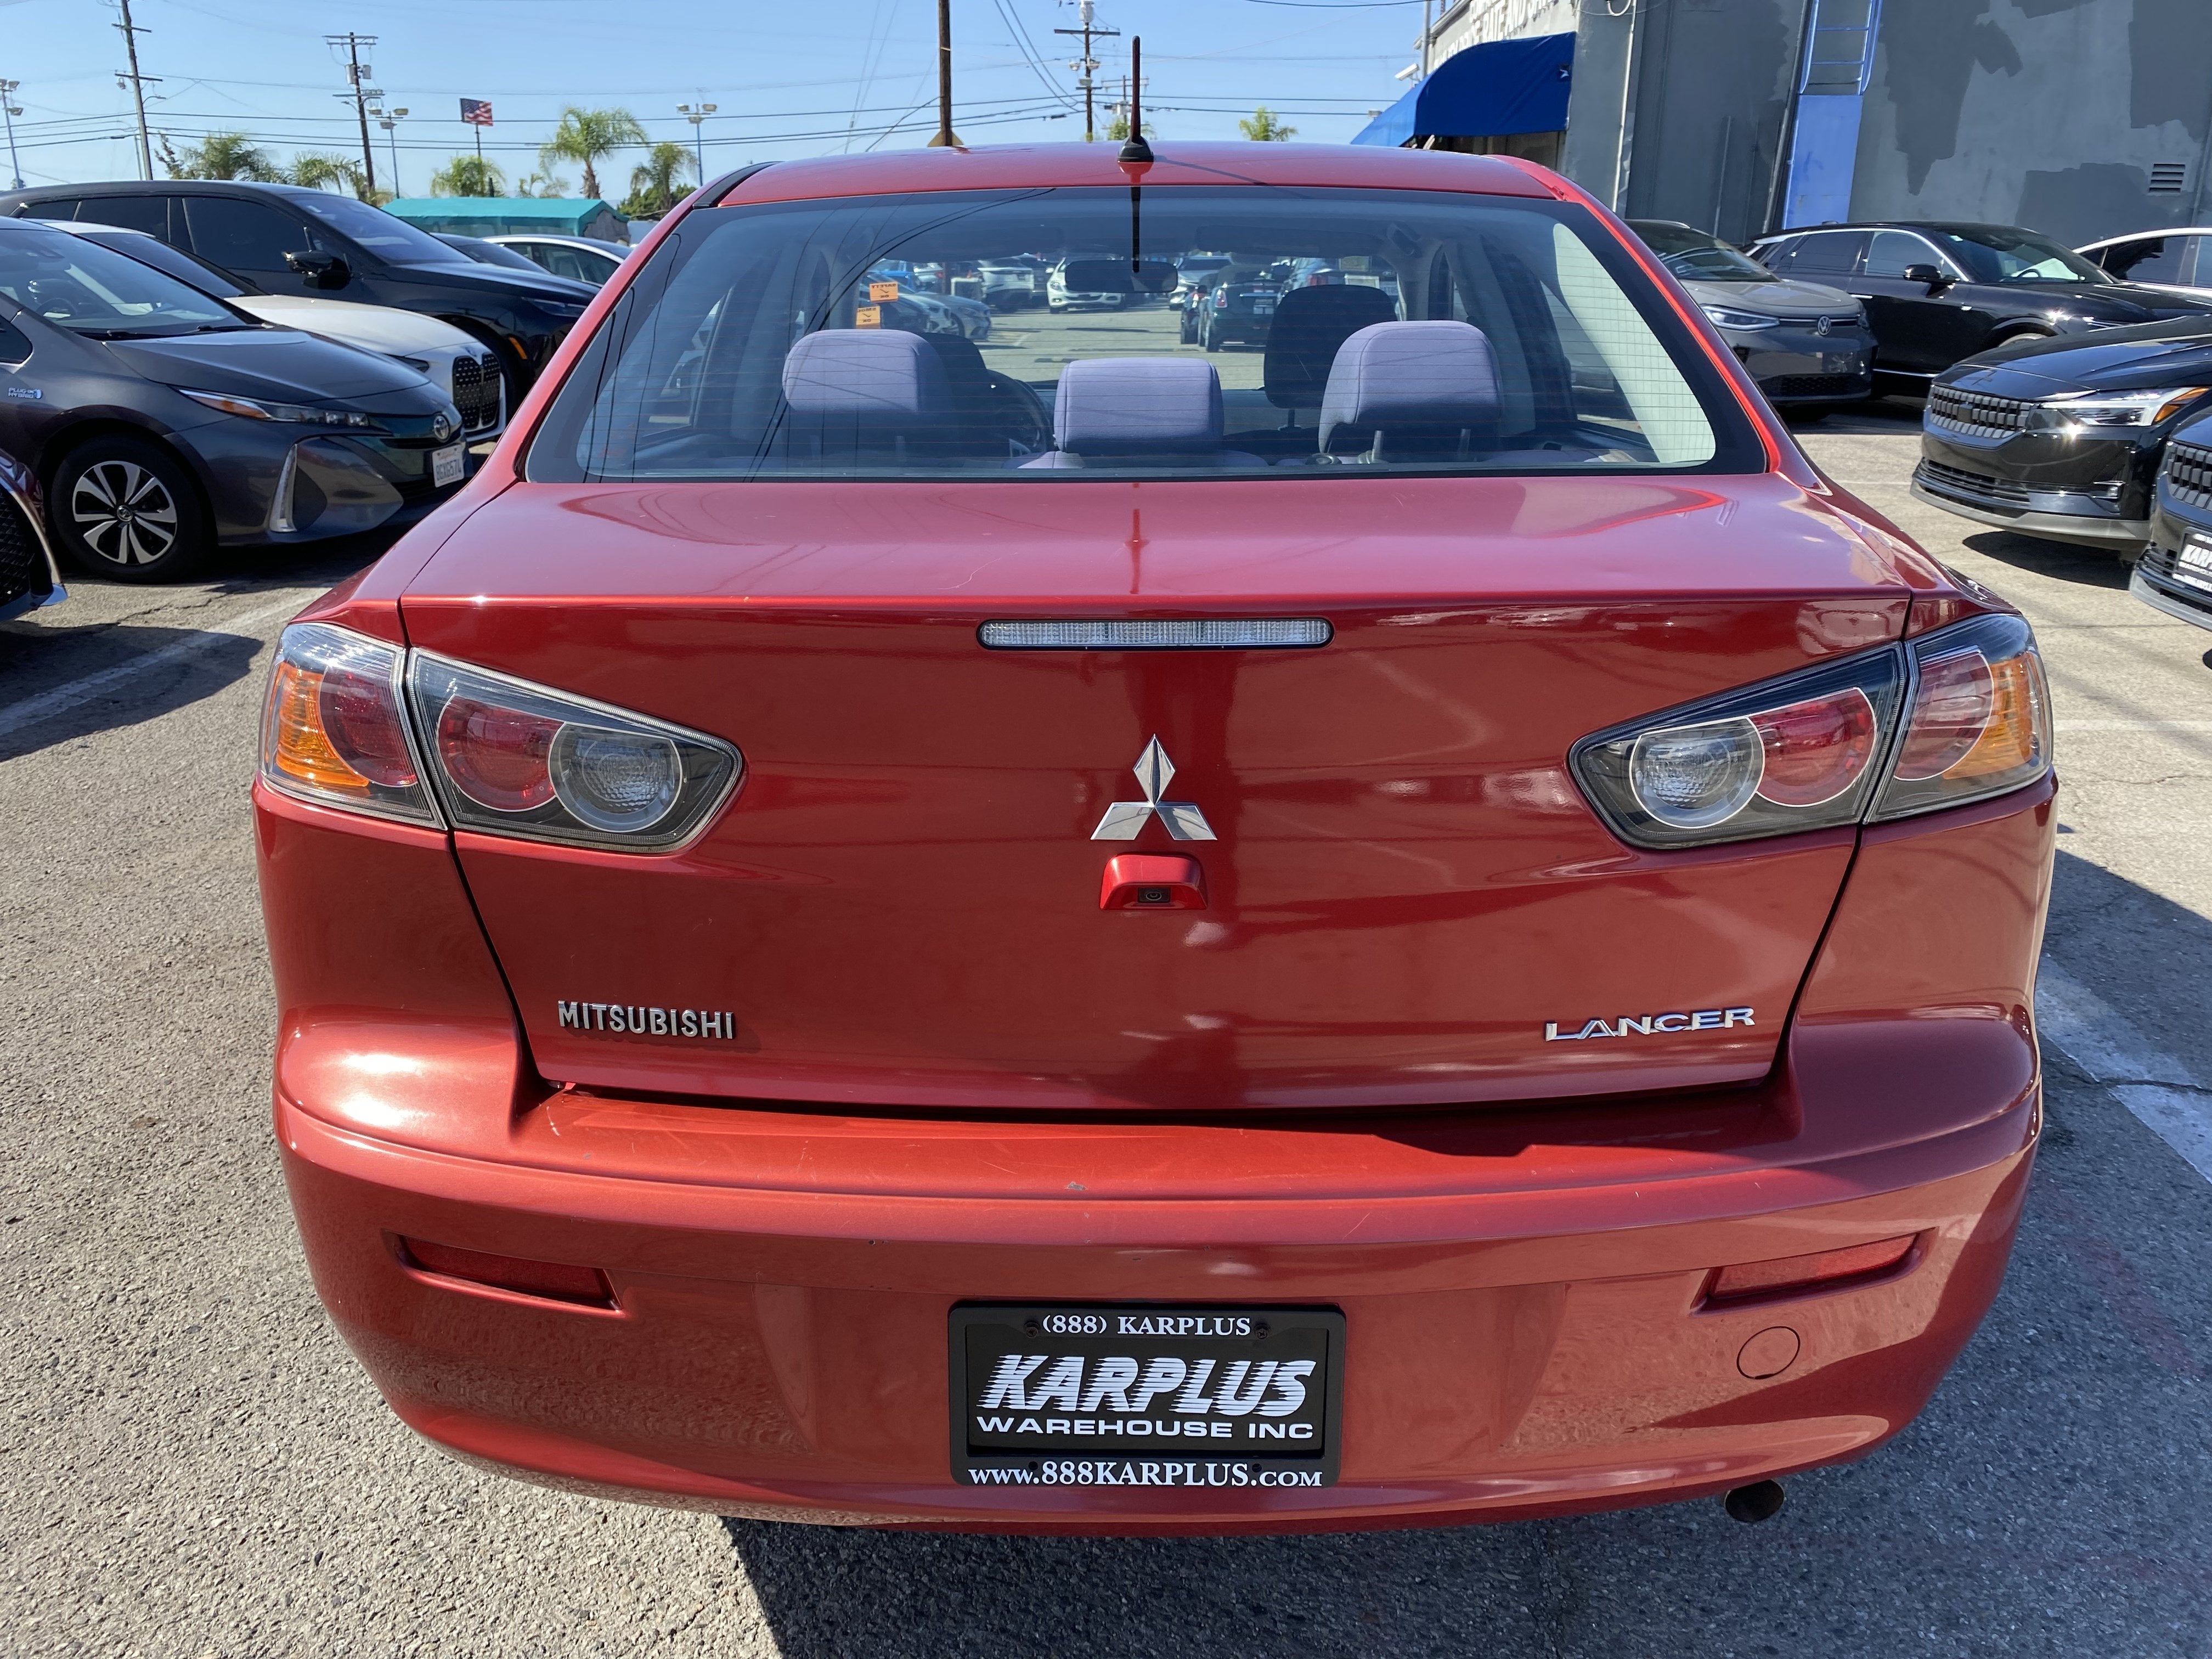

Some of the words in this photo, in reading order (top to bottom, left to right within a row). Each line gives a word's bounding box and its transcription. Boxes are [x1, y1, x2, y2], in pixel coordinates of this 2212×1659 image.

[558, 1000, 733, 1039] MITSUBISHI
[1545, 1007, 1755, 1041] LANCER
[1042, 1314, 1108, 1335] (888)
[1117, 1316, 1251, 1336] KARPLUS
[976, 1354, 1317, 1417] KARPLUS
[976, 1416, 1233, 1438] WAREHOUSE
[1248, 1423, 1313, 1439] INC
